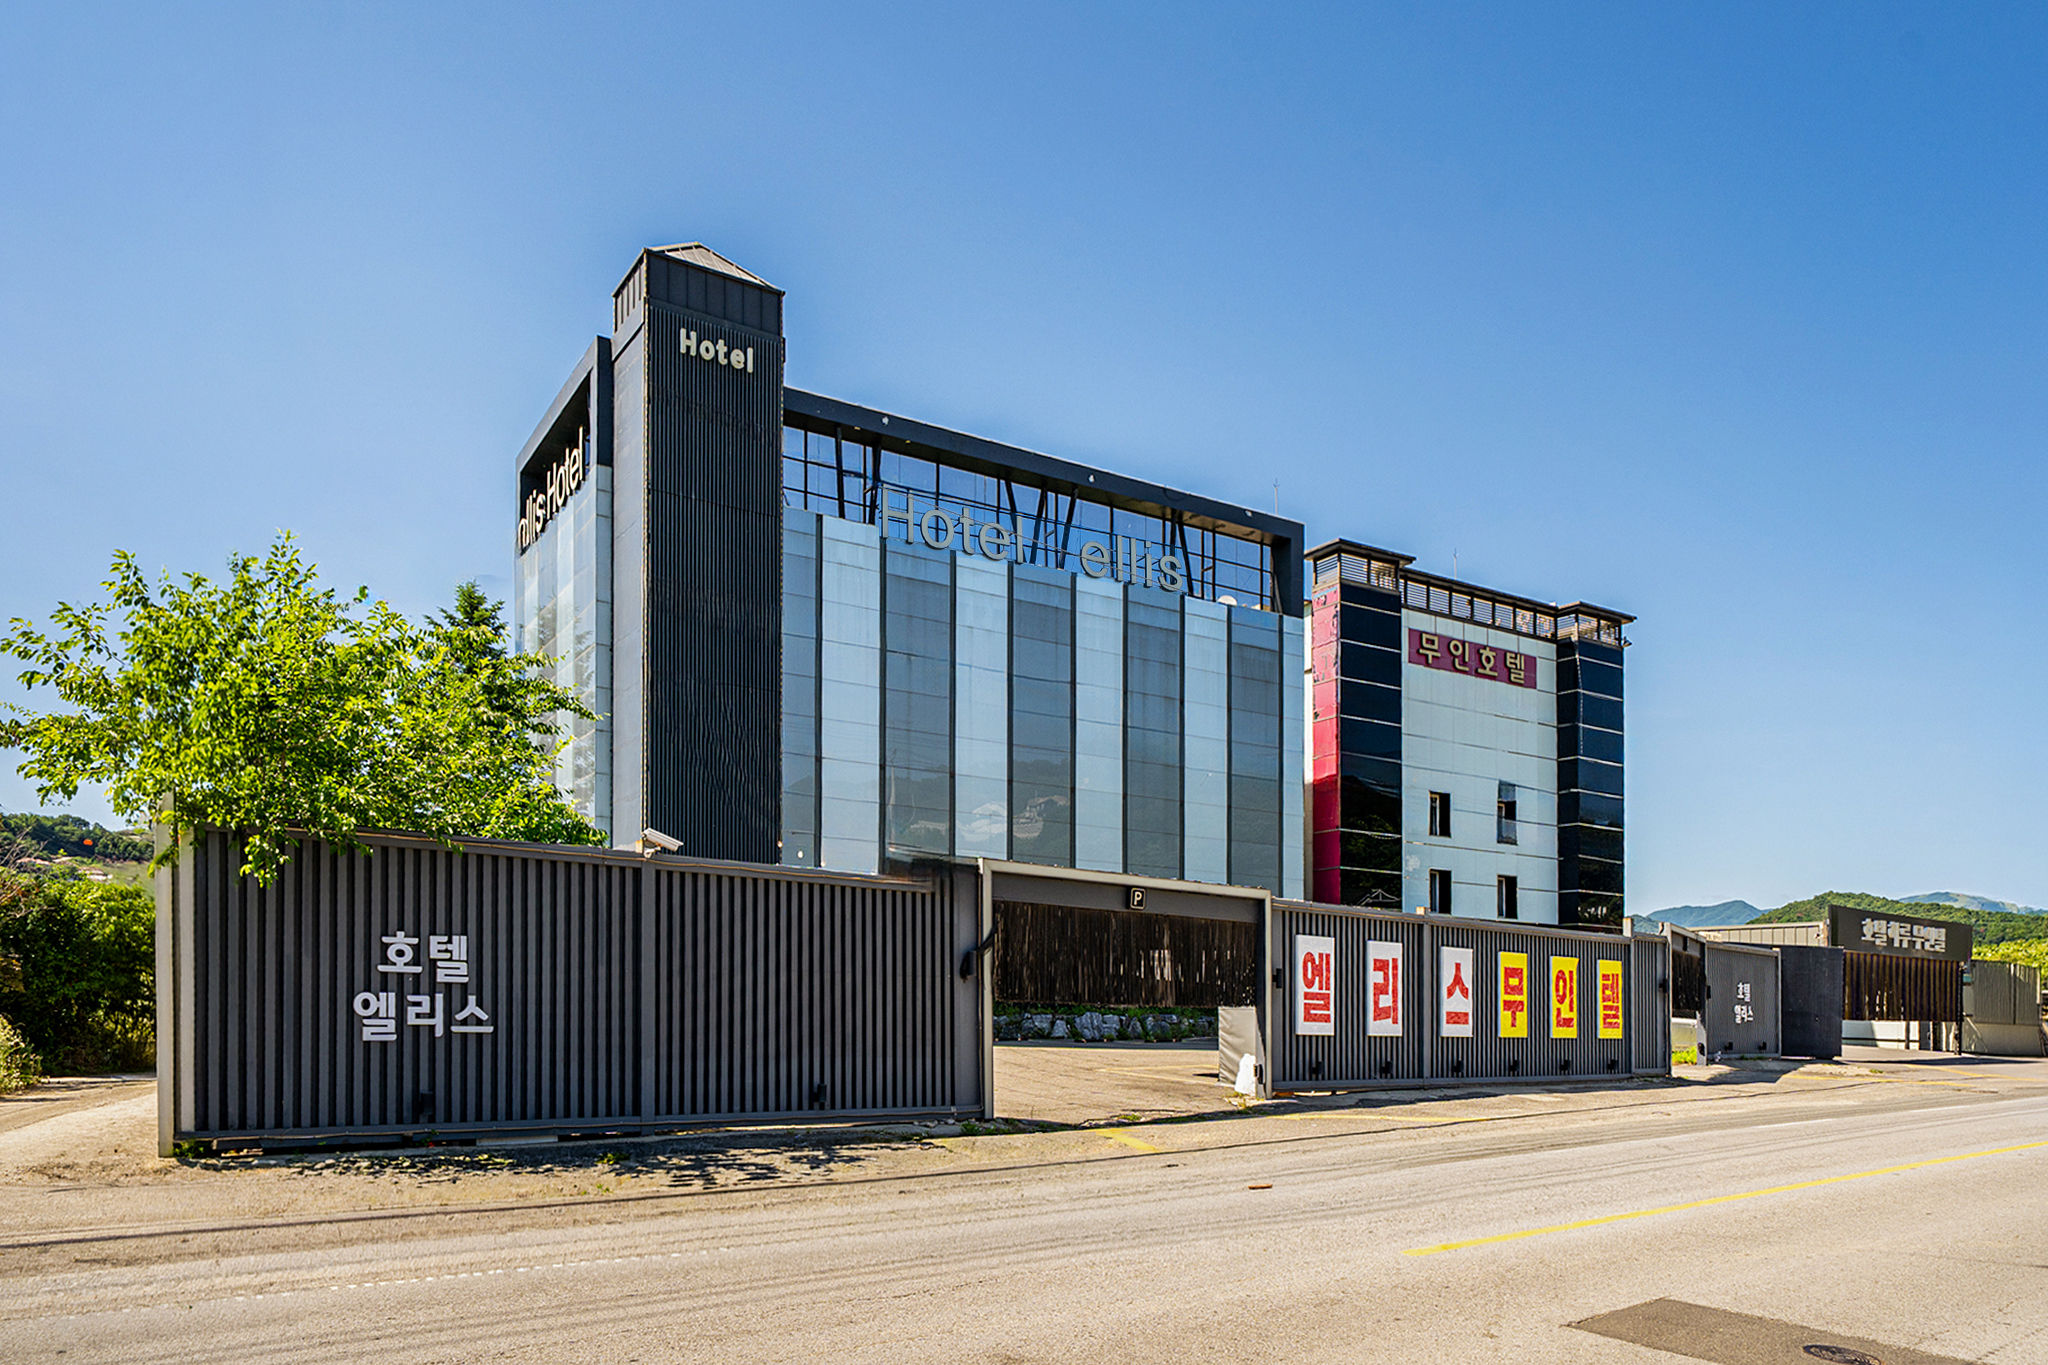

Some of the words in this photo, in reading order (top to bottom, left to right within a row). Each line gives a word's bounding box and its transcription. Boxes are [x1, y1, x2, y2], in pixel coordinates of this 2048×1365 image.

[680, 327, 754, 373] Hotel
[546, 425, 585, 520] Hotel
[881, 483, 1024, 564] Hotel
[1080, 534, 1183, 592] ellis
[1419, 632, 1525, 684] 무인호텔
[1134, 891, 1142, 906] P
[376, 930, 470, 983] 호텔
[353, 991, 494, 1042] 엘리스
